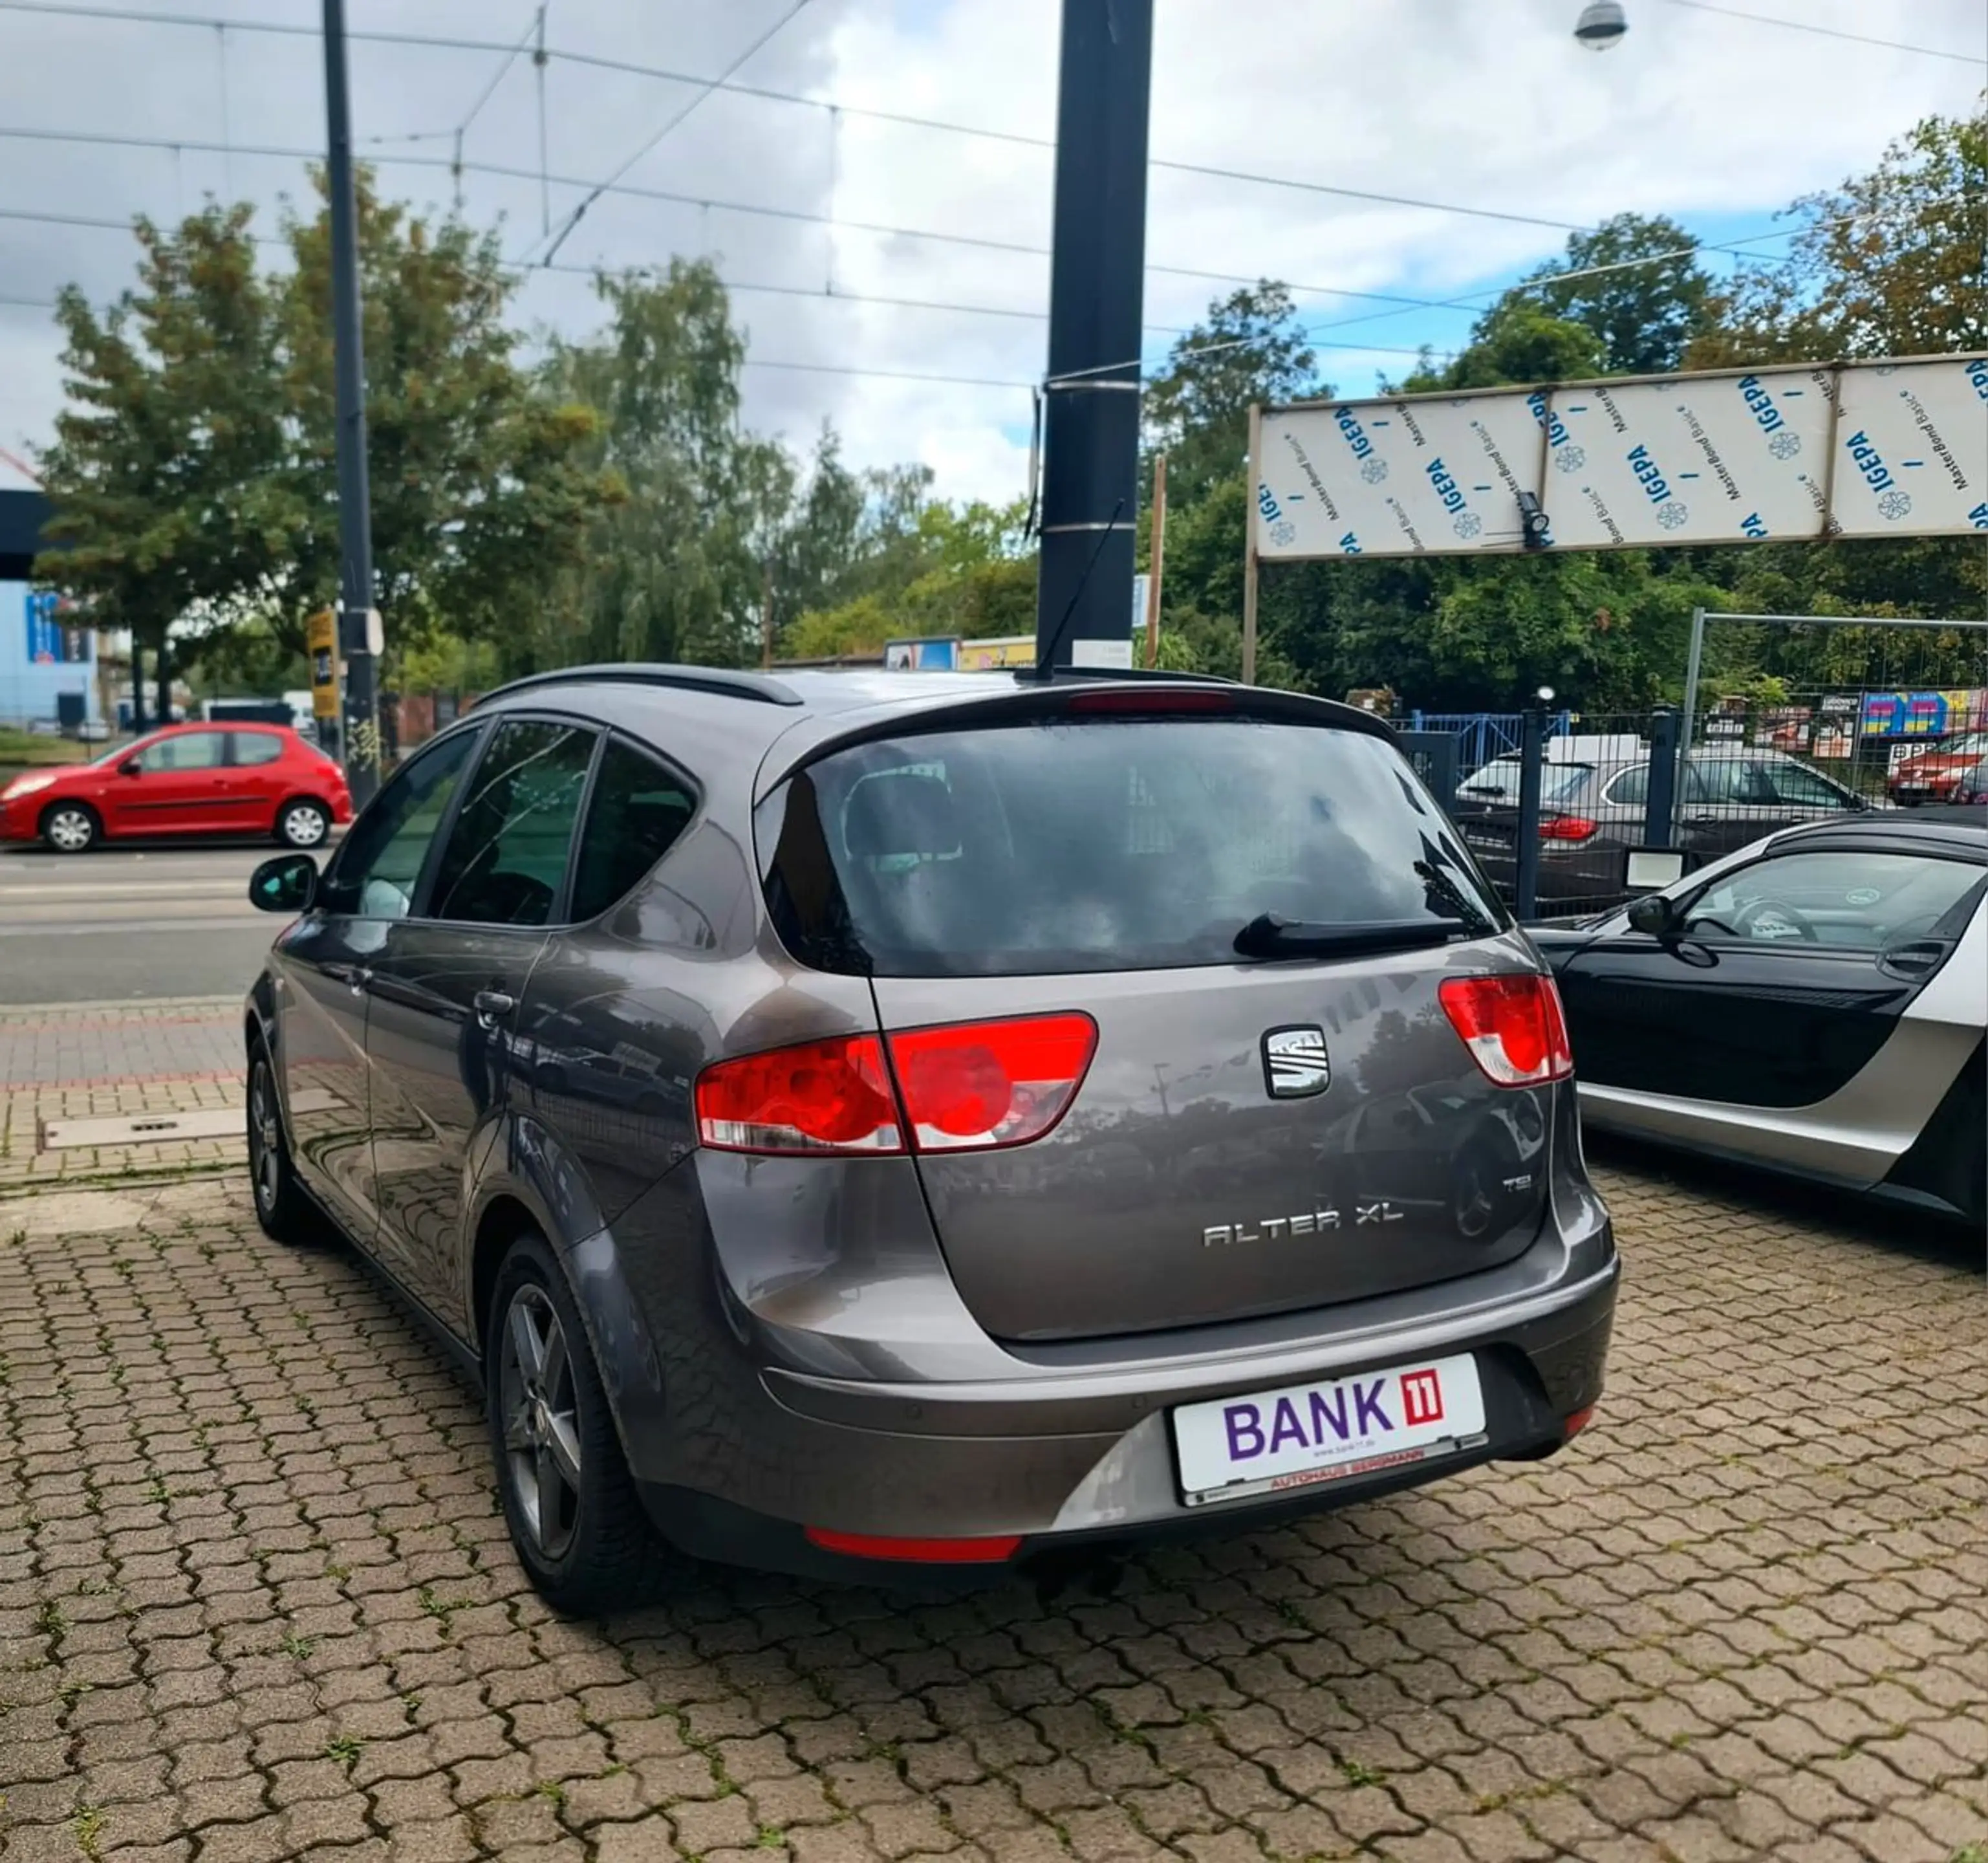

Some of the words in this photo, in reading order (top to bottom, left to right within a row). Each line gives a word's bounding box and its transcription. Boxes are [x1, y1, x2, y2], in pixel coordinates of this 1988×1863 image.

[1334, 406, 1374, 460] IGEPA
[1738, 374, 1786, 433] IGEPA
[1426, 457, 1467, 514] IGEPA
[1626, 443, 1672, 504] IGEPA
[1846, 430, 1895, 493] IGEPA
[1920, 423, 1969, 491] MasterBond
[1356, 1201, 1404, 1226] XL
[1223, 1378, 1394, 1461] BANK
[1403, 1374, 1440, 1422] 11
[1270, 1464, 1347, 1490] AUTOHAUS
